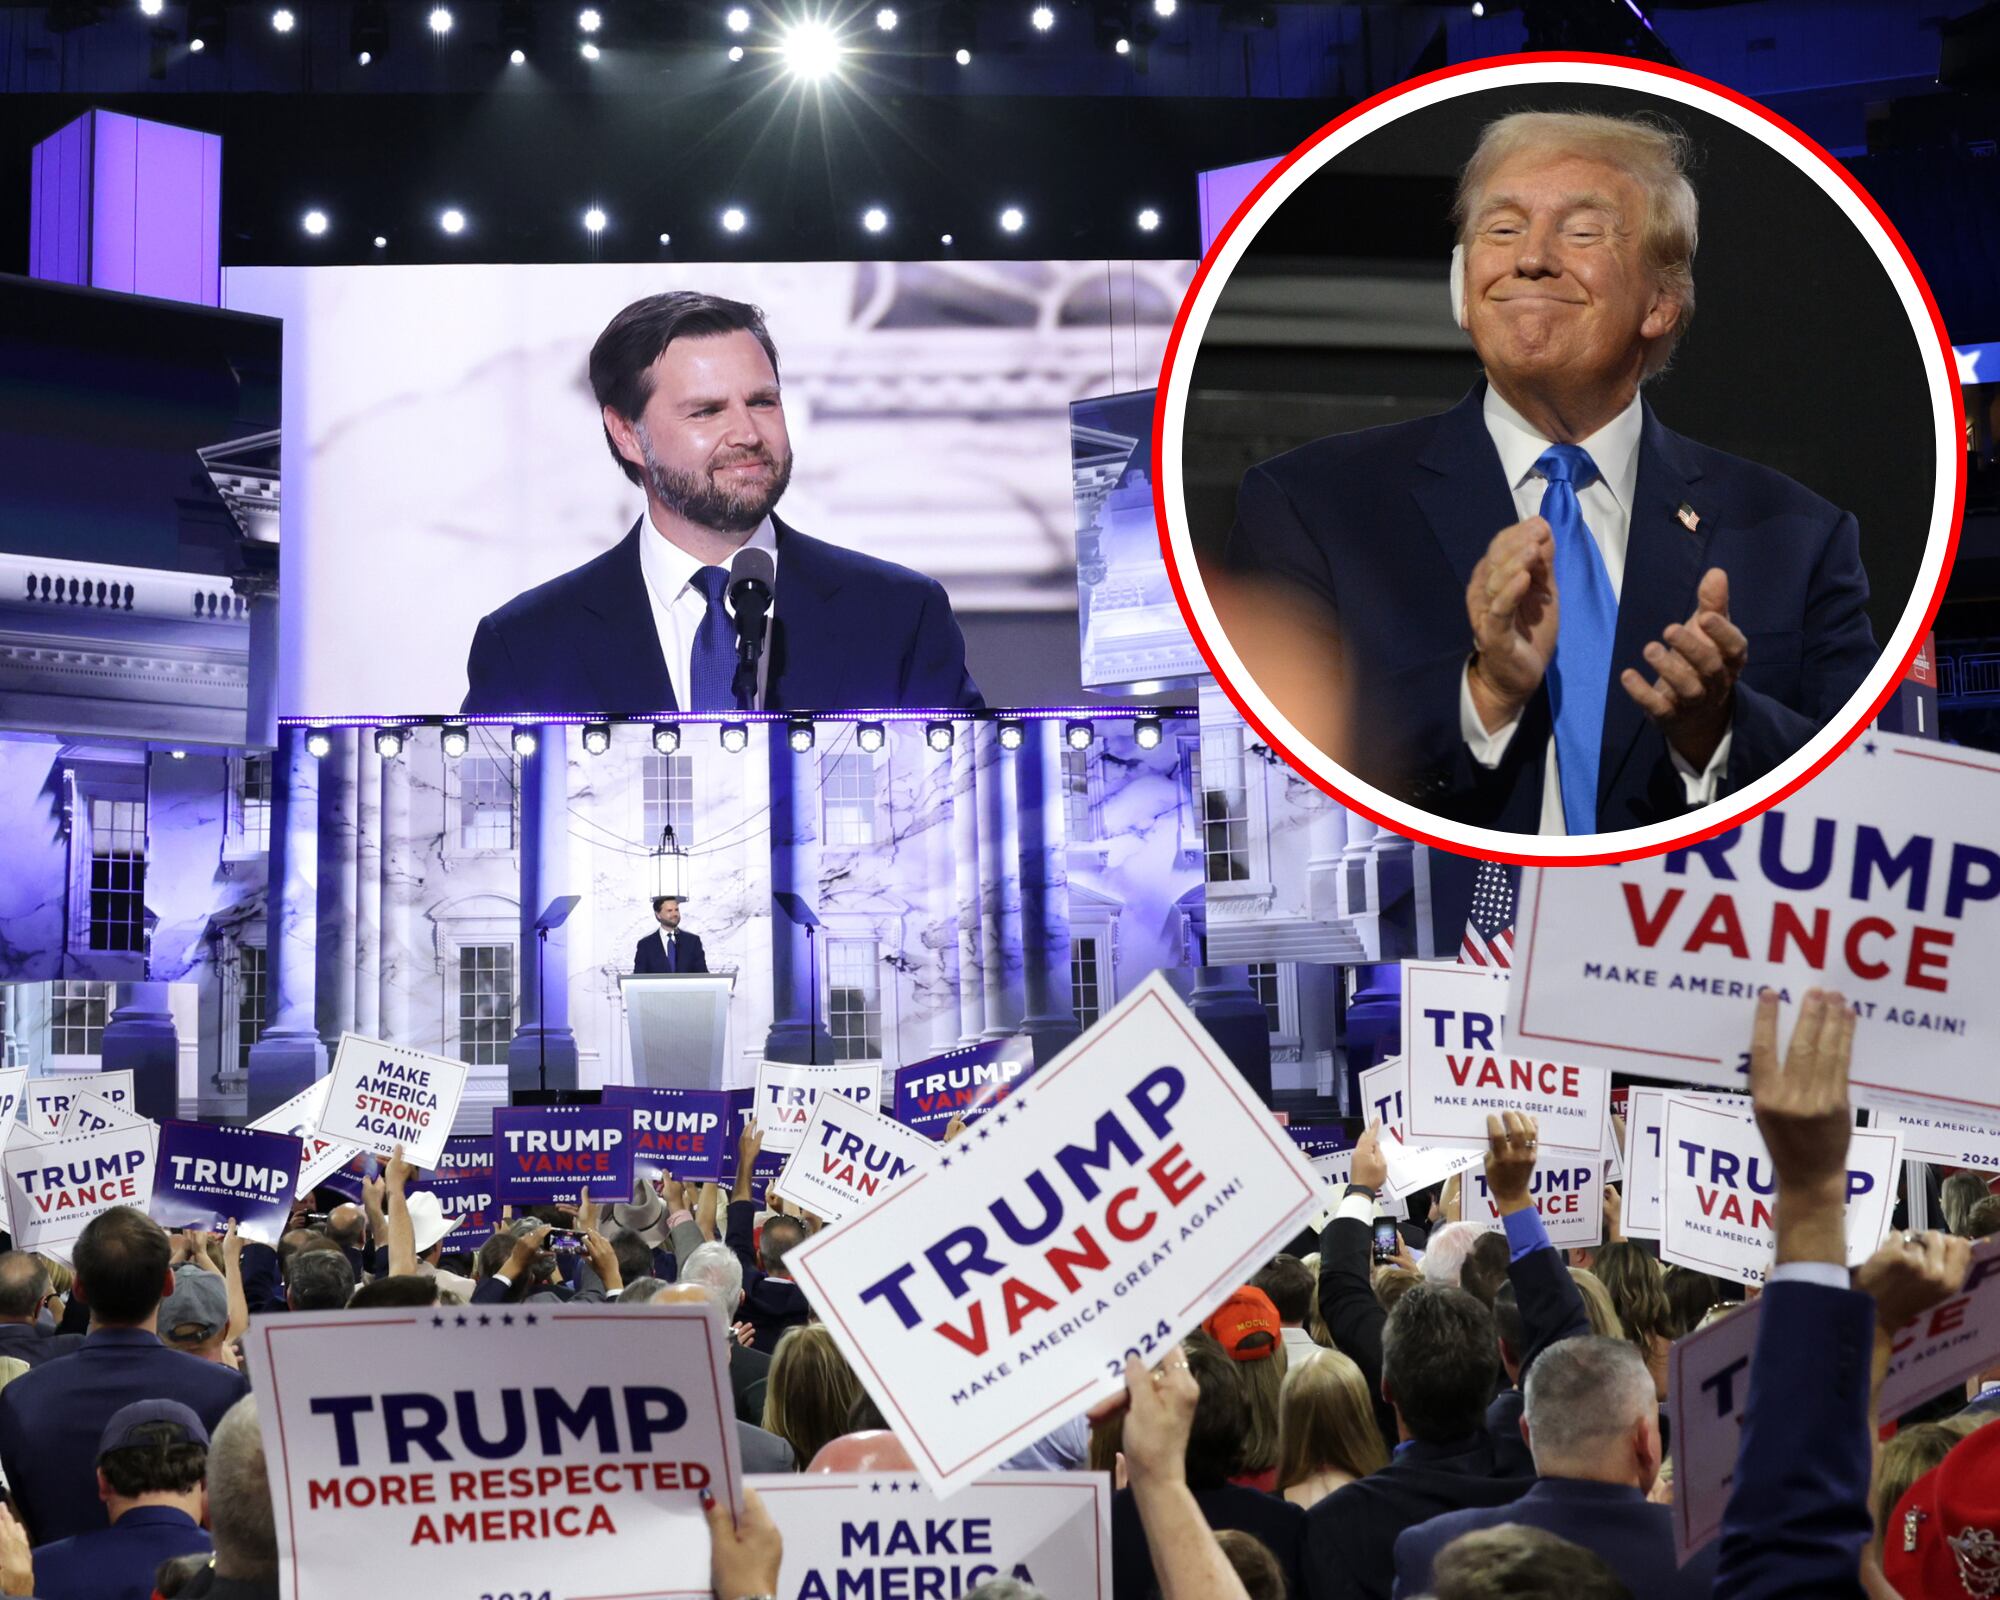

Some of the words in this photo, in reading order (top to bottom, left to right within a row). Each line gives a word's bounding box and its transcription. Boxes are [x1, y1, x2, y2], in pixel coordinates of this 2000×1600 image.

[1622, 882, 1955, 993] VANCE
[1584, 961, 1658, 988] MAKE
[1885, 1007, 1967, 1036] AGAIN!
[377, 1060, 431, 1087] MAKE
[904, 1060, 1022, 1099] TRUMP
[1446, 1055, 1580, 1097] VANCE
[355, 1075, 437, 1110] AMERICA
[917, 1083, 1011, 1113] VANCE
[1434, 1096, 1467, 1106] MAKE
[1472, 1098, 1522, 1110] AMERICA
[1525, 1102, 1554, 1113] GREAT
[1556, 1107, 1587, 1117] AGAIN!
[355, 1094, 431, 1127] STRONG
[632, 1109, 718, 1134] RUMP
[911, 1115, 932, 1124] MAKE
[1898, 1116, 1930, 1127] MAKE
[1934, 1121, 1985, 1134] AMERICA
[355, 1114, 422, 1144] AGAIN!
[504, 1129, 623, 1152] TRUMP
[633, 1133, 705, 1152] ANCE
[373, 1142, 395, 1153] 202
[518, 1153, 609, 1172] VANCE
[1961, 1152, 1999, 1166] 2024
[16, 1150, 145, 1194] TRUMP
[170, 1155, 289, 1194] TRUMP
[34, 1177, 136, 1213] VANCE
[174, 1183, 197, 1191] MAKE
[198, 1185, 233, 1196] AMERICA
[235, 1190, 258, 1200] GREAT
[258, 1193, 280, 1204] AGAIN!
[552, 1194, 577, 1202] 2024
[804, 1172, 825, 1188] MAKE
[826, 1184, 860, 1204] AMERICA
[859, 1065, 1186, 1331] TRUMP
[30, 1217, 52, 1227] MAKE
[55, 1211, 91, 1222] AMERICA
[438, 1193, 492, 1215] UMP
[1561, 1217, 1585, 1225] AGAIN!
[1685, 1219, 1712, 1234] MAKE
[1716, 1229, 1762, 1248] AMERICA
[933, 1142, 1207, 1358] VANCE
[1742, 1267, 1766, 1282] 202
[951, 1363, 1013, 1407] MAKE
[1018, 1299, 1112, 1366] AMERICA
[1113, 1240, 1174, 1298] GREAT
[1179, 1176, 1245, 1243] AGAIN!
[1106, 1318, 1173, 1378] 2024
[1913, 1329, 1979, 1364] AGAIN!
[309, 1385, 688, 1467] TRUMP
[307, 1472, 436, 1510] MORE
[449, 1461, 711, 1502] RESPECTED
[410, 1503, 617, 1546] AMERICA
[841, 1518, 992, 1558] MAKE
